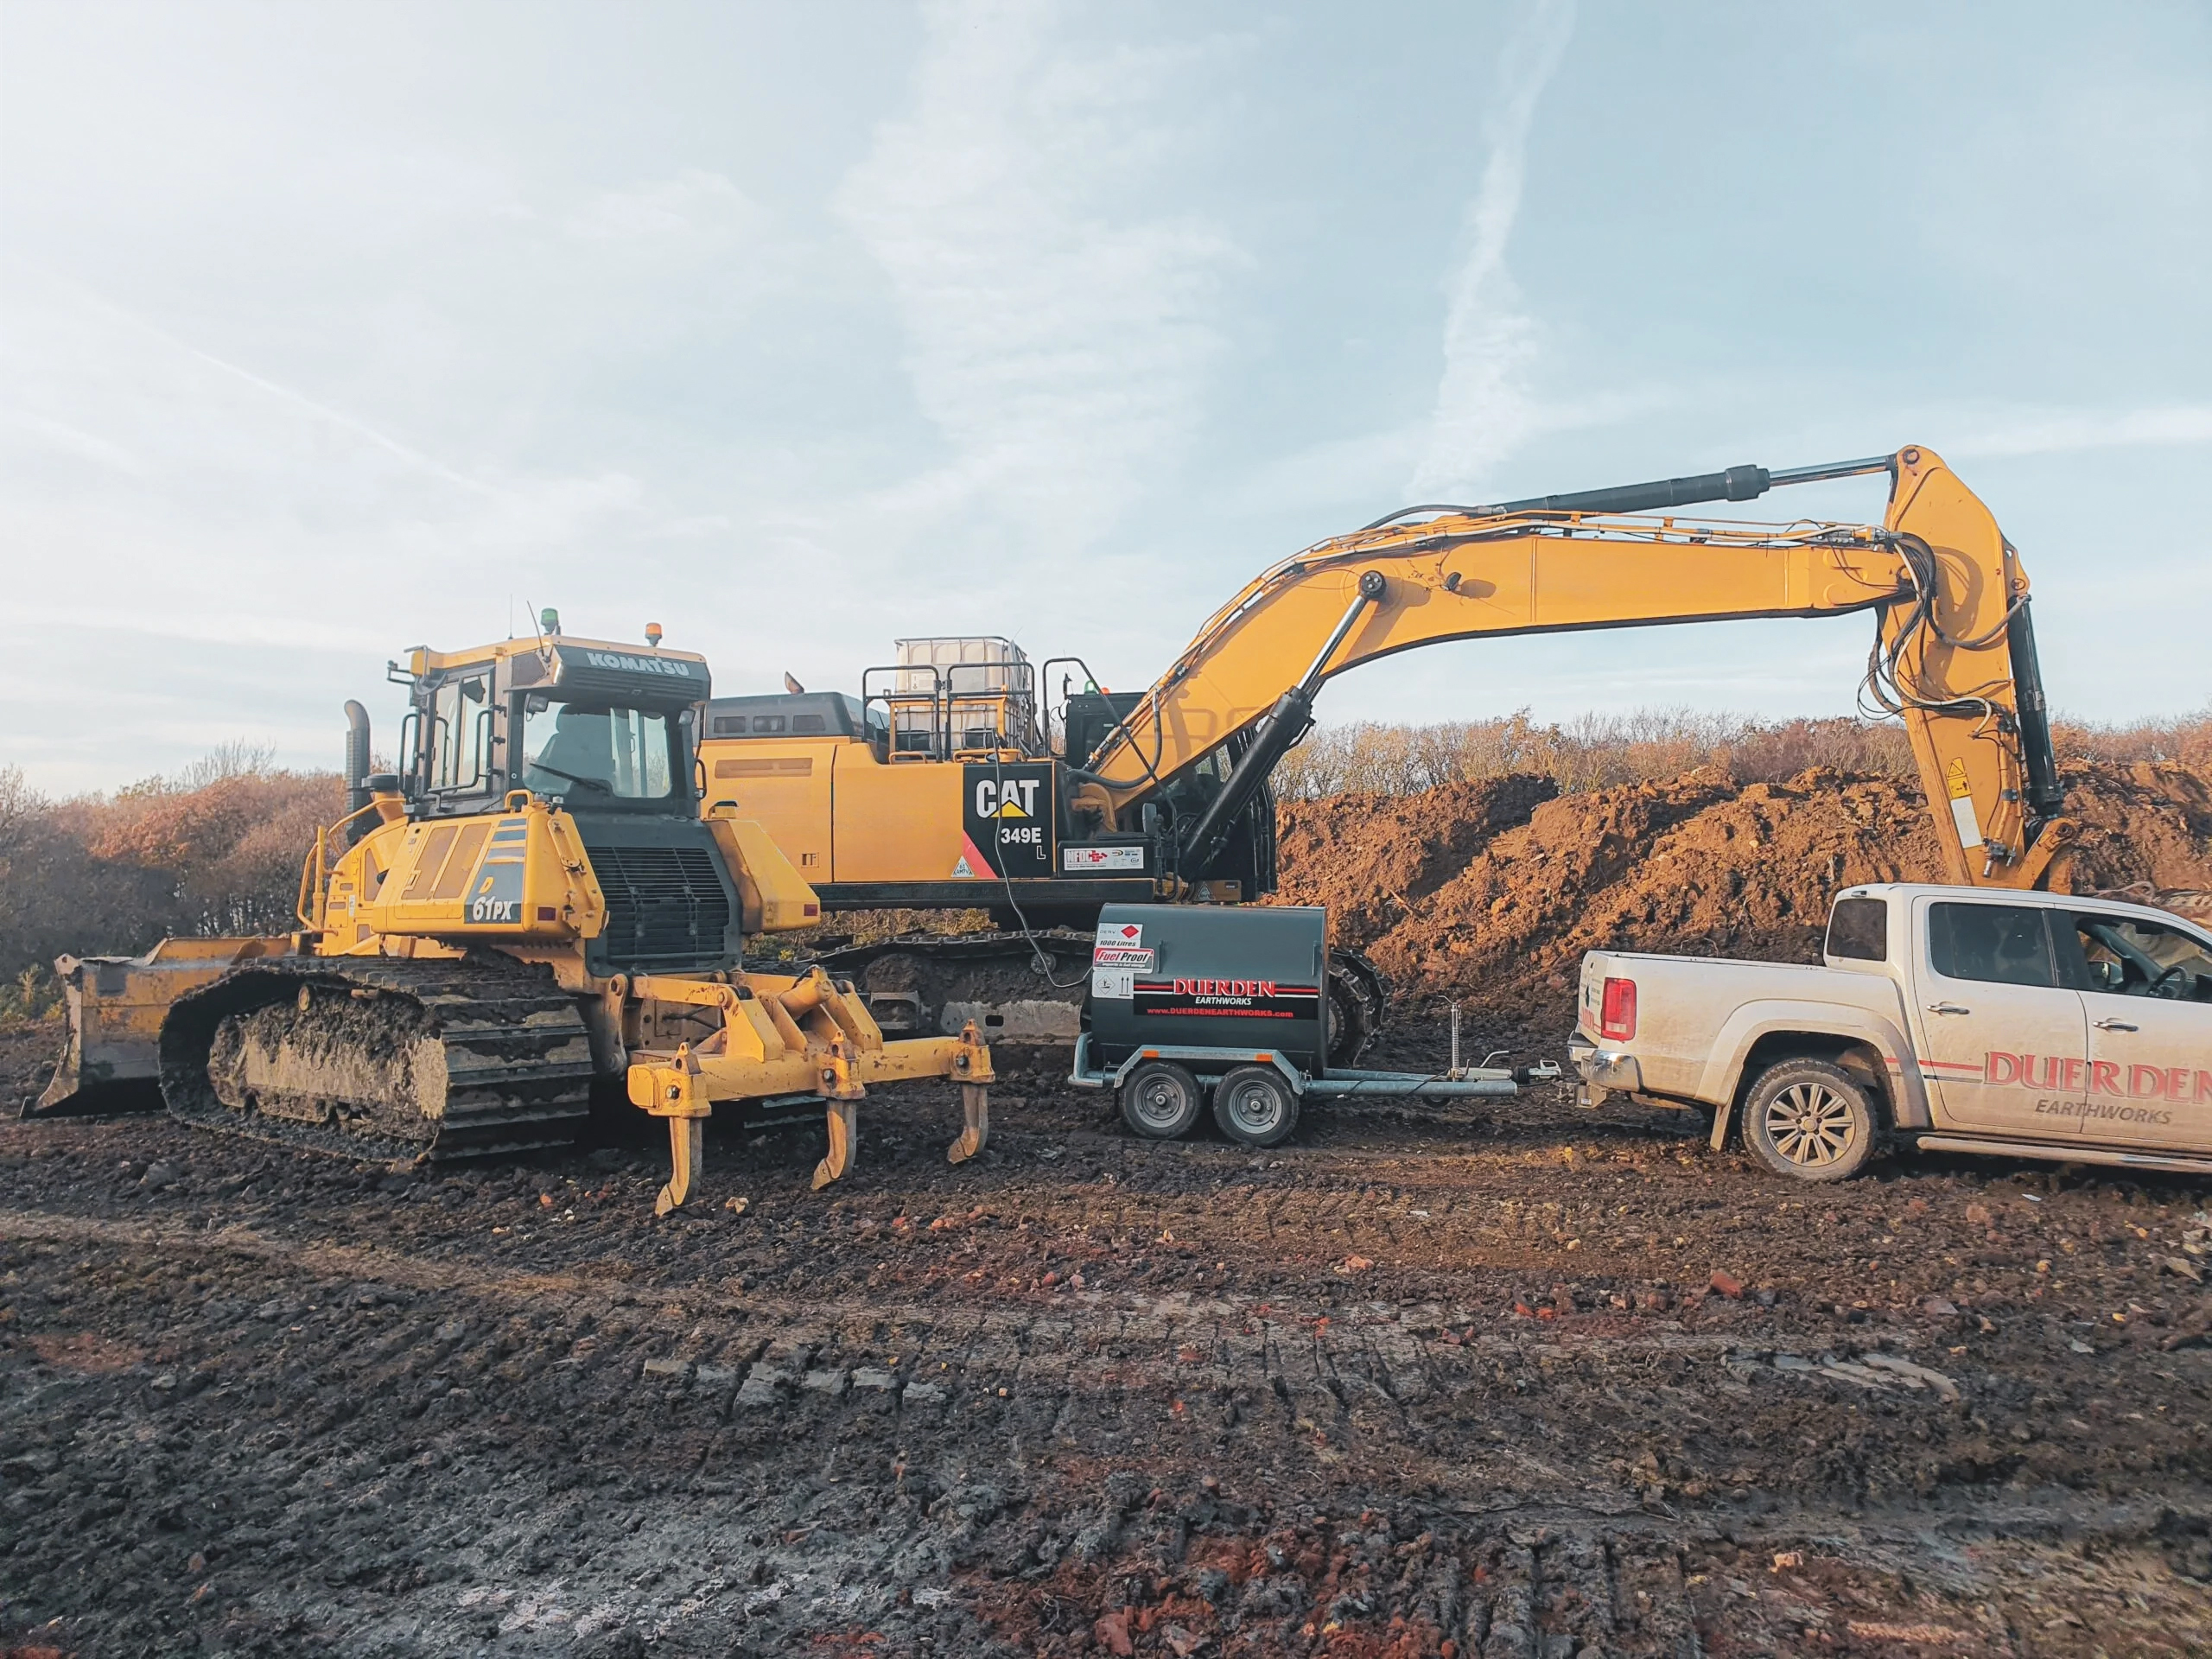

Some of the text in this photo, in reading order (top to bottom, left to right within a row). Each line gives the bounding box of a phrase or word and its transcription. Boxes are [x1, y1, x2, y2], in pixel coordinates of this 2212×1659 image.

[587, 652, 690, 677] KOMATSU
[976, 779, 1040, 818] CAT
[1001, 827, 1042, 843] 349E
[1036, 845, 1046, 860] L
[478, 876, 495, 893] D
[473, 895, 513, 921] 61PX
[1098, 951, 1149, 962] Fuel Proof
[1173, 978, 1276, 997] DUERDEN
[1195, 996, 1252, 1006] EARTHWORKS
[1147, 1007, 1294, 1018] www.DUERDENEARTHWORKS.com
[2035, 1099, 2173, 1124] EARTHWORKS
